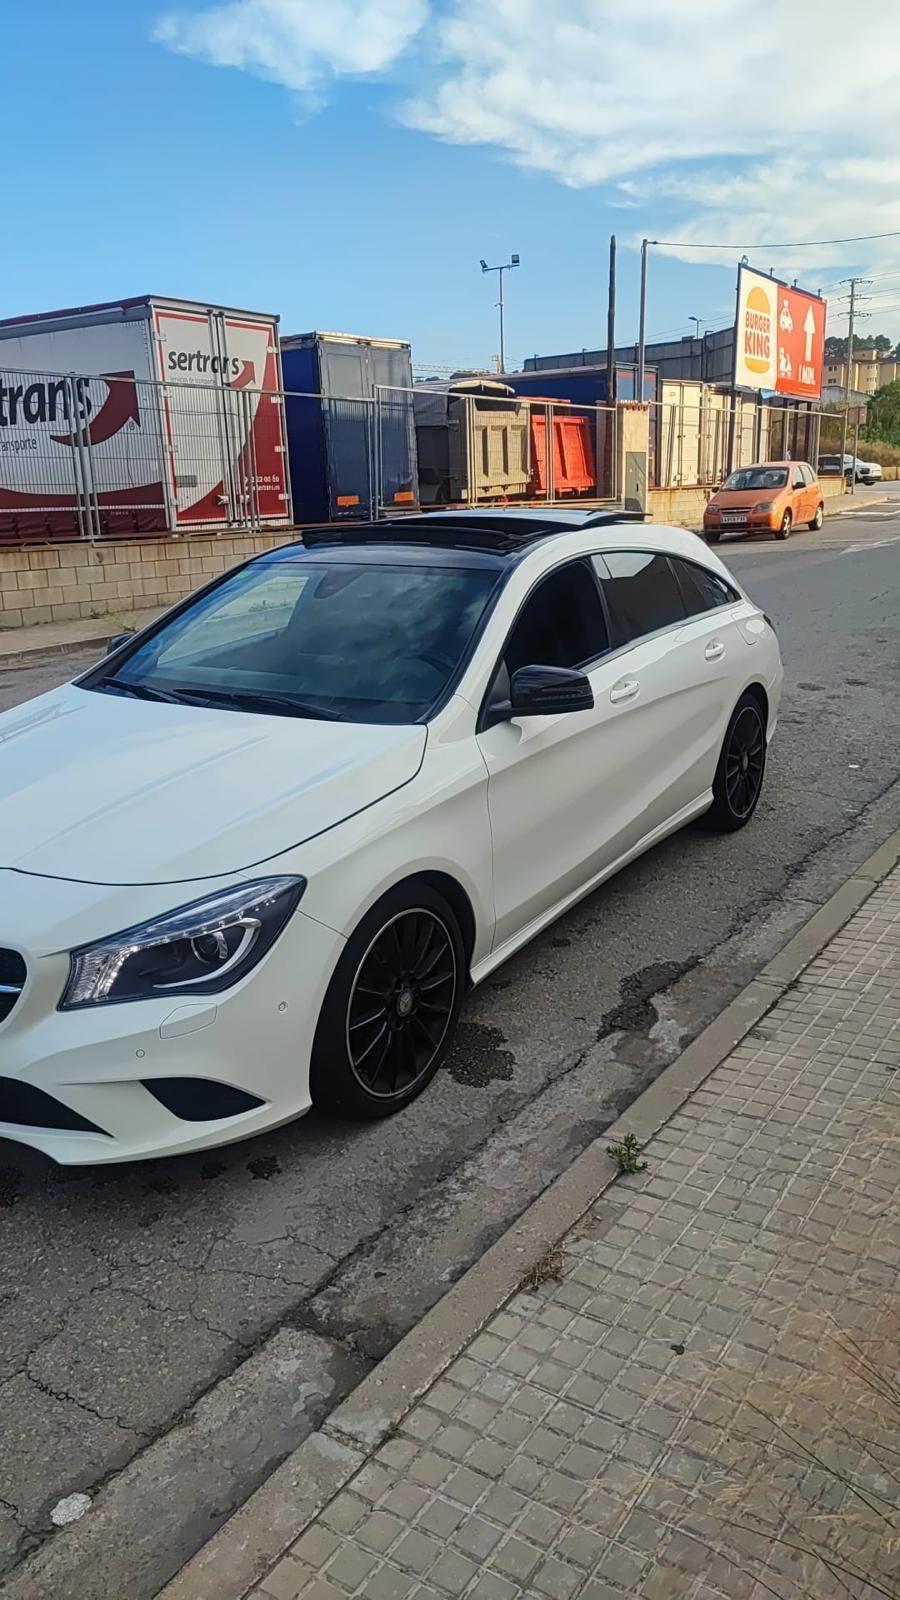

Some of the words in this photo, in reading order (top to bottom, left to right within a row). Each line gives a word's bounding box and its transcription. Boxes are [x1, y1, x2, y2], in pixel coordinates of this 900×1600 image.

[746, 311, 770, 333] BURGER
[745, 330, 770, 359] KING
[168, 350, 239, 375] sertrans
[0, 437, 38, 454] ansporte
